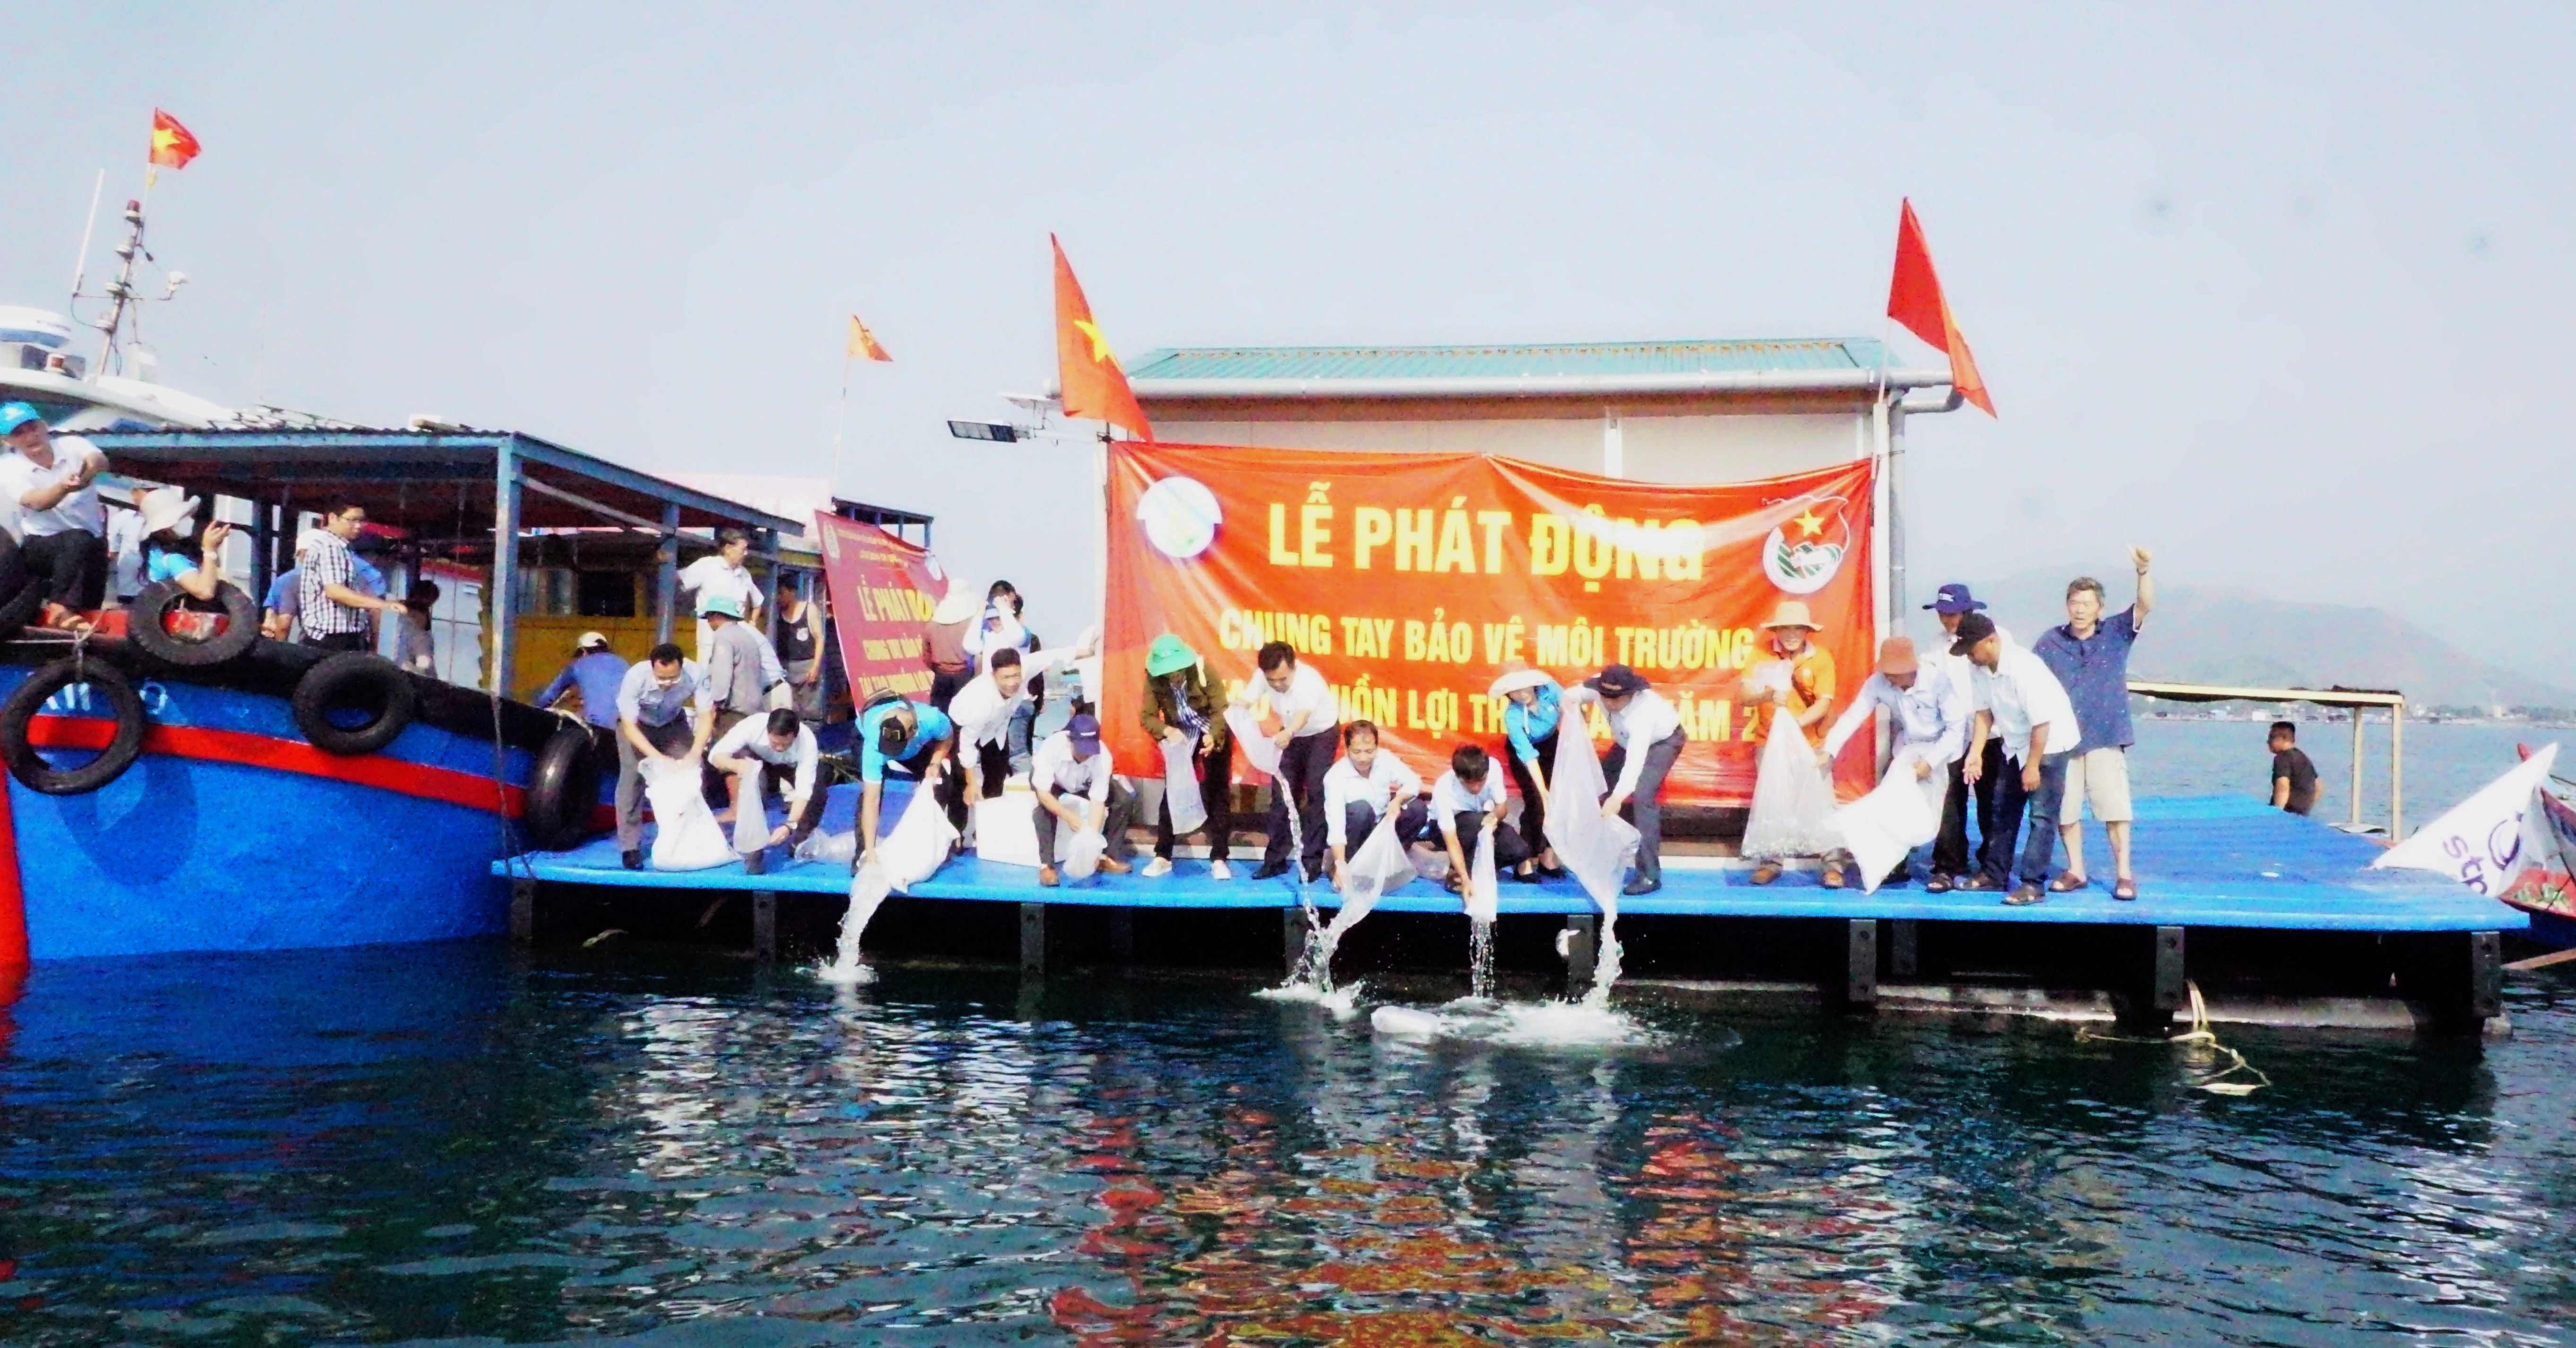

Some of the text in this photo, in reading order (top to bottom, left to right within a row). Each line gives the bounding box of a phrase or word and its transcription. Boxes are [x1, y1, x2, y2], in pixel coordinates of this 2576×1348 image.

[1269, 481, 1703, 592] LỄ PHÁT ĐỘNG
[1219, 608, 1332, 655] CHUNG
[1340, 616, 1394, 659] TAY
[1405, 607, 1473, 664] BẢO
[1537, 616, 1604, 667] MÔI
[1615, 619, 1755, 670] TRƯỜNG
[1408, 688, 1459, 740] LỢI
